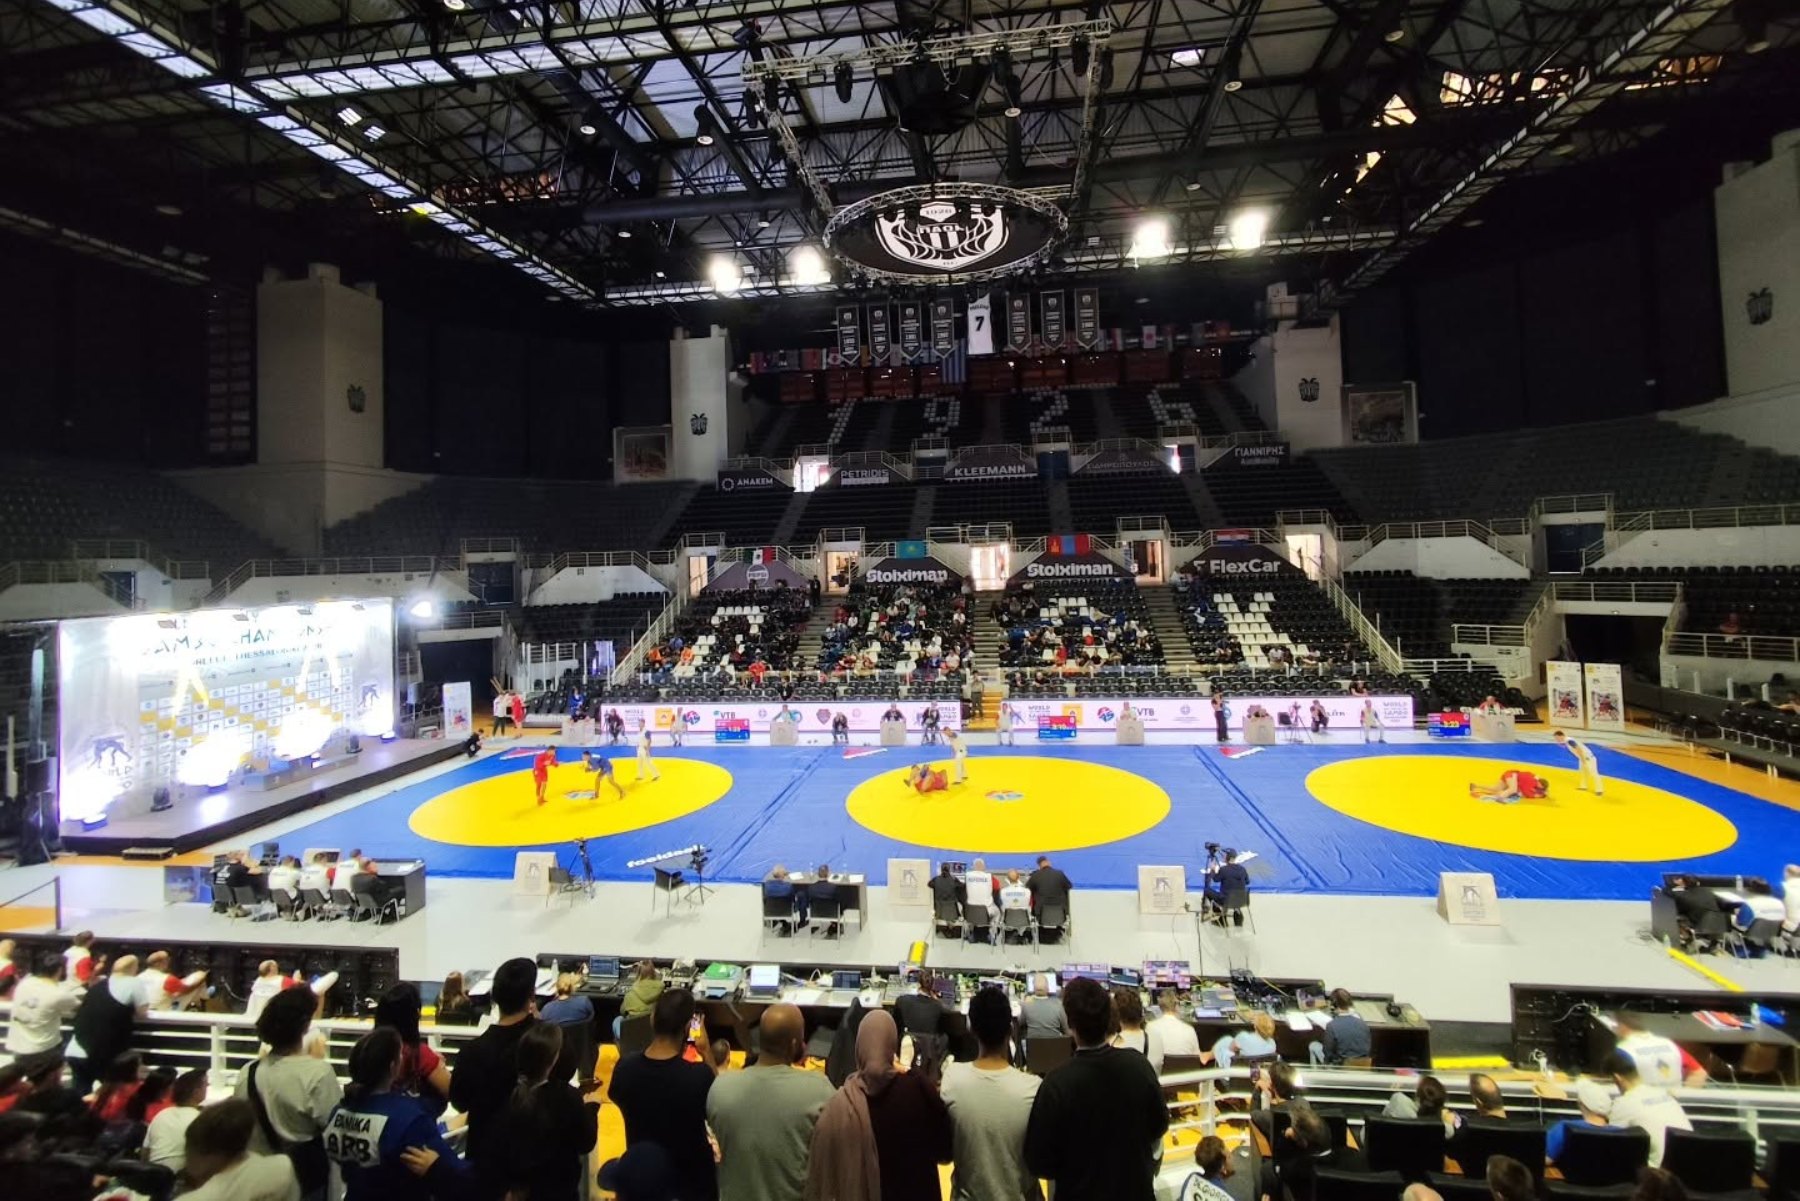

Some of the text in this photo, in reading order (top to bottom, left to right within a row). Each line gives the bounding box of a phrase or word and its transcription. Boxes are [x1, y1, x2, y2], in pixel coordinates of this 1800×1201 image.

[975, 316, 985, 331] 7
[840, 469, 889, 478] PETRIDIS
[954, 464, 1026, 477] KLEEMANN
[737, 477, 773, 487] ANAKEM
[1027, 561, 1114, 578] Stoiximan
[1210, 559, 1281, 575] FlexCar
[866, 568, 948, 584] Stoiximan
[720, 712, 736, 720] VTB
[1137, 707, 1155, 717] VTB
